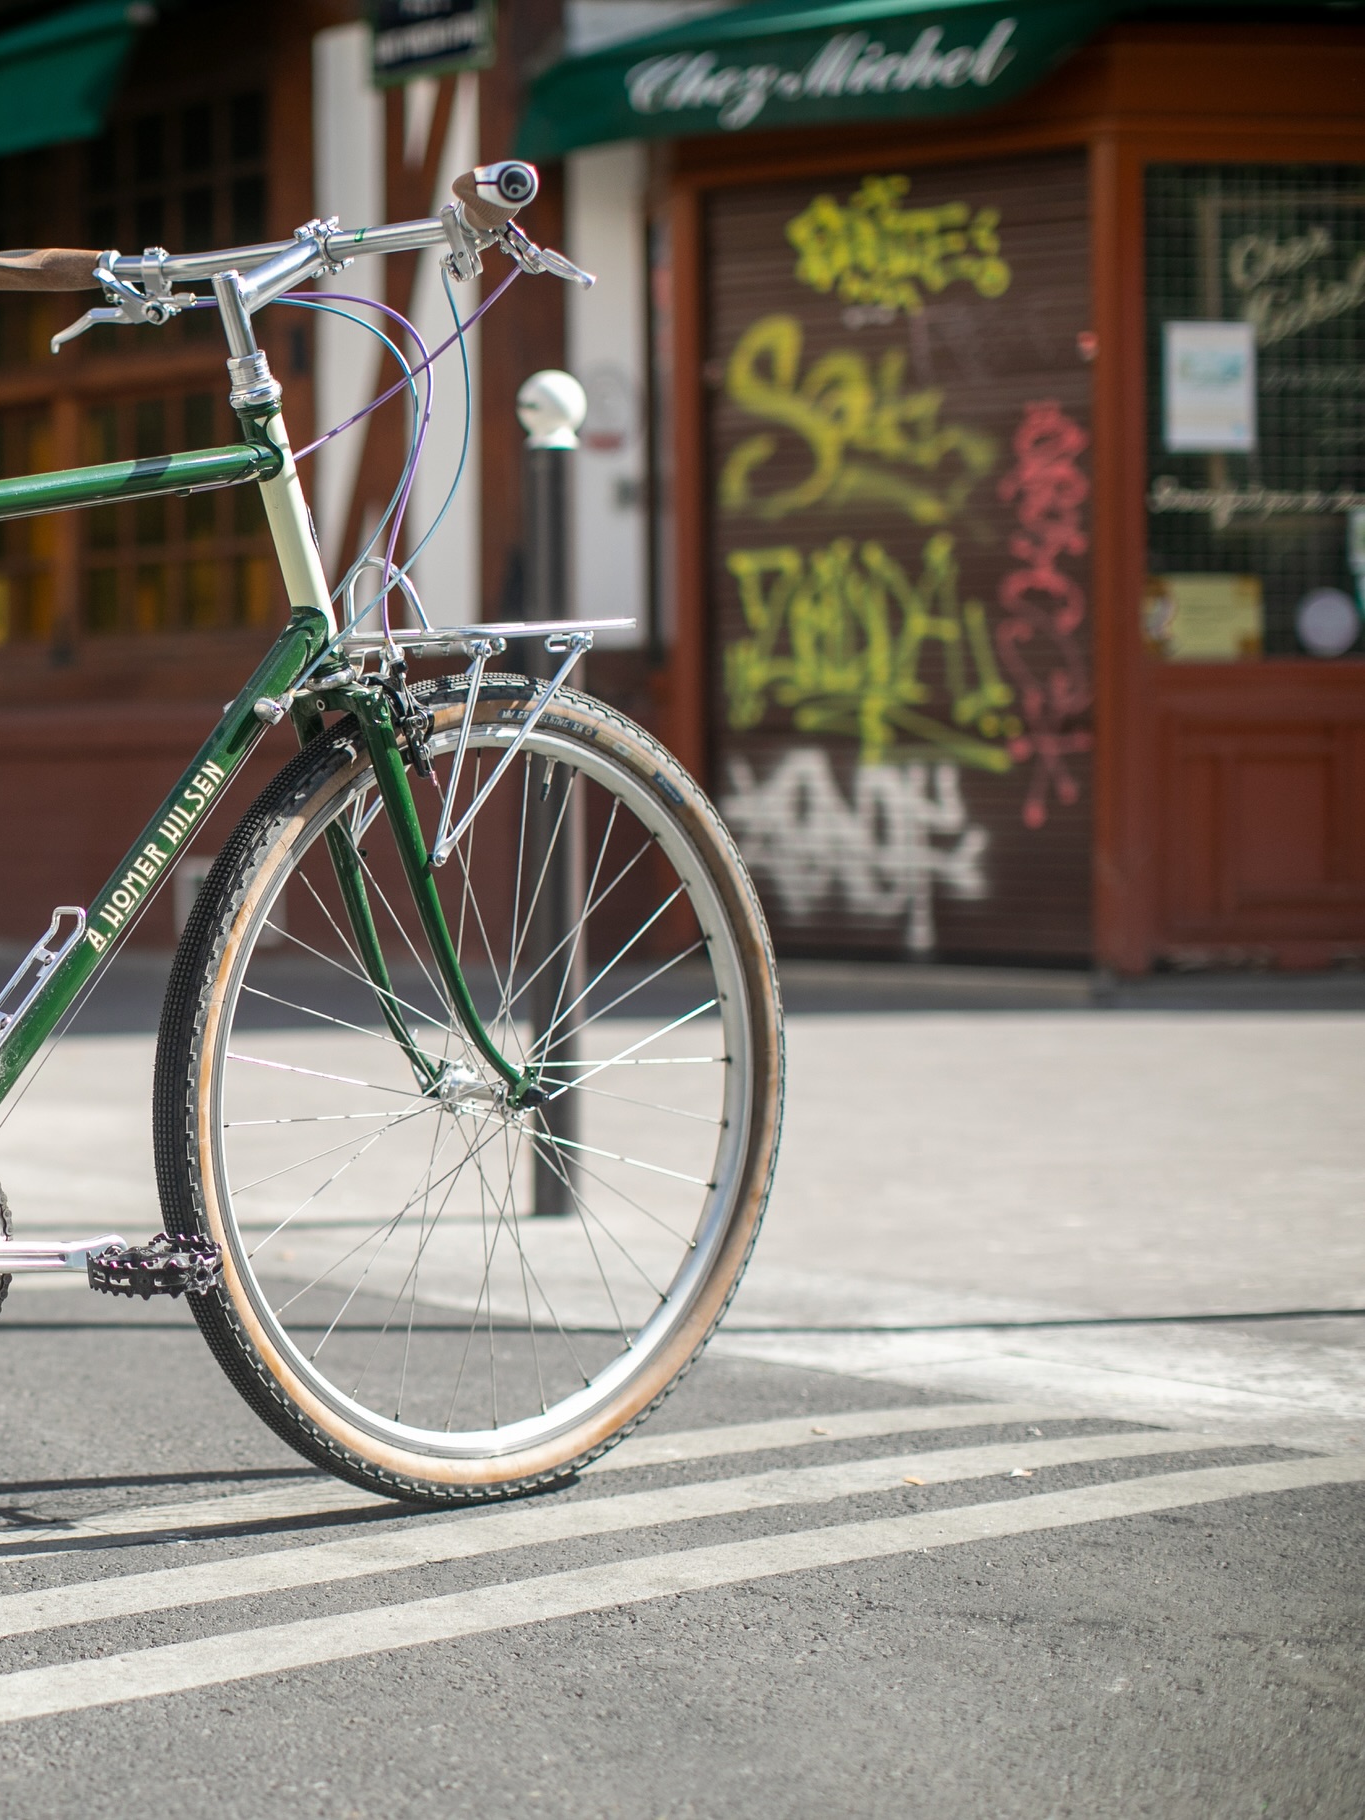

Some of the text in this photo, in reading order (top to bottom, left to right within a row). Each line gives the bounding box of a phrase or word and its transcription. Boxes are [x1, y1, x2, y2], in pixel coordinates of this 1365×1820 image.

[624, 17, 1018, 131] Chez Michel
[516, 710, 570, 728] GRELKING
[86, 759, 225, 953] A. HOMER HILSEN
